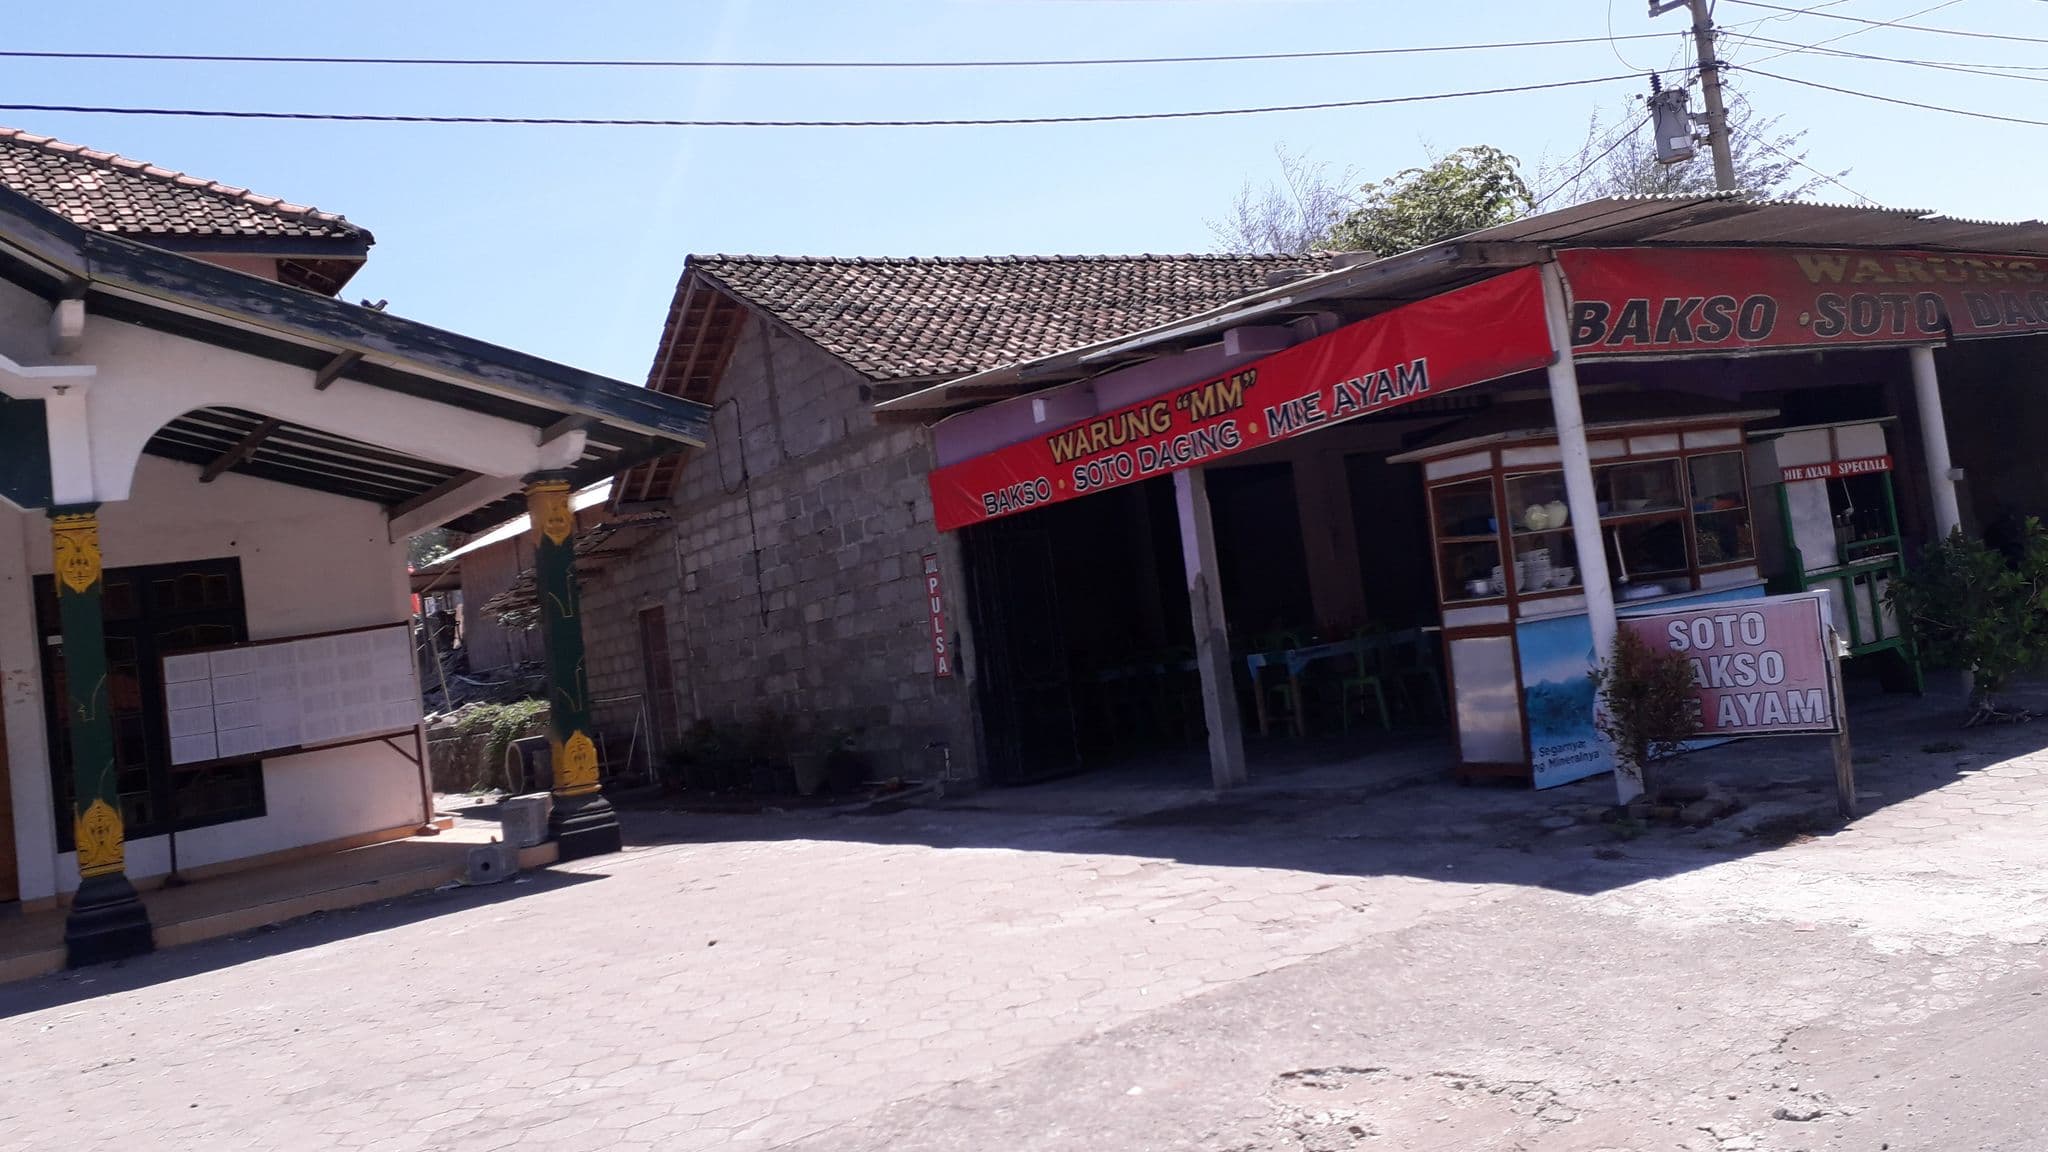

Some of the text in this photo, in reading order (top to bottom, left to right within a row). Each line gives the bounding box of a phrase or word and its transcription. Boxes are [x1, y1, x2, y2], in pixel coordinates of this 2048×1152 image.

[1572, 294, 1778, 347] BAKSO
[1813, 292, 1951, 338] SOTO
[984, 358, 1430, 516] BAKSO SOTO DAGING MIE AYAM
[1048, 401, 1172, 464] WARUNG
[1784, 468, 1803, 481] MIE
[1805, 464, 1831, 479] AYAM
[929, 577, 948, 674] PULSA
[1667, 611, 1767, 652] SOTO
[1689, 650, 1786, 690] AKSO
[1716, 688, 1827, 729] AYAM
